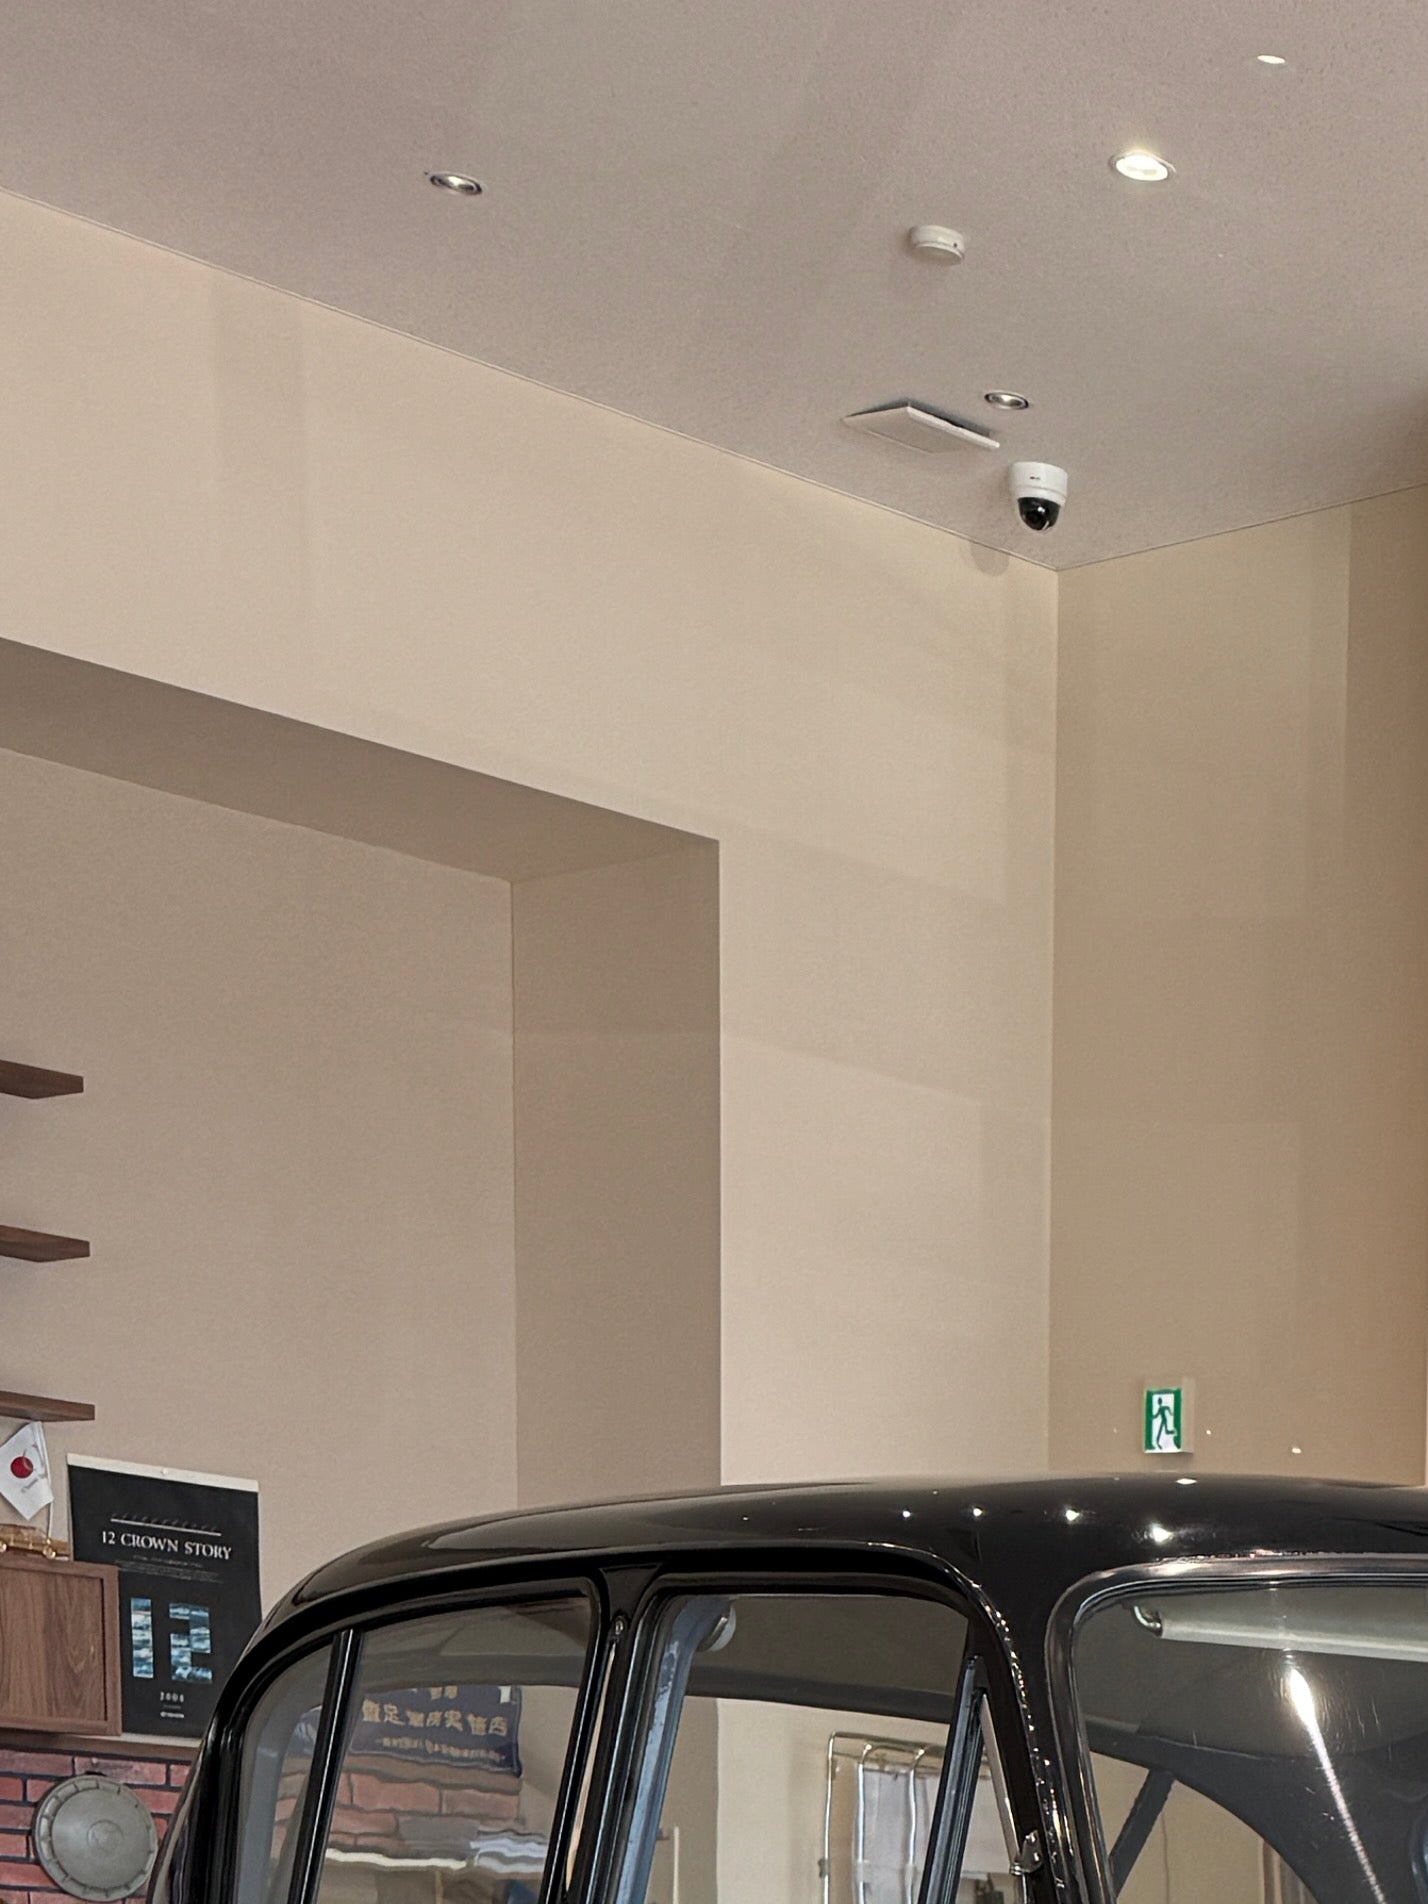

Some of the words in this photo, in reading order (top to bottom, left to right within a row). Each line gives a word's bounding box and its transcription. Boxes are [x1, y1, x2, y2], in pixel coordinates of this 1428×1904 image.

[101, 1529, 116, 1546] 12
[120, 1532, 179, 1553] CROWN
[184, 1541, 231, 1560] STORY
[131, 1597, 213, 1684] 12
